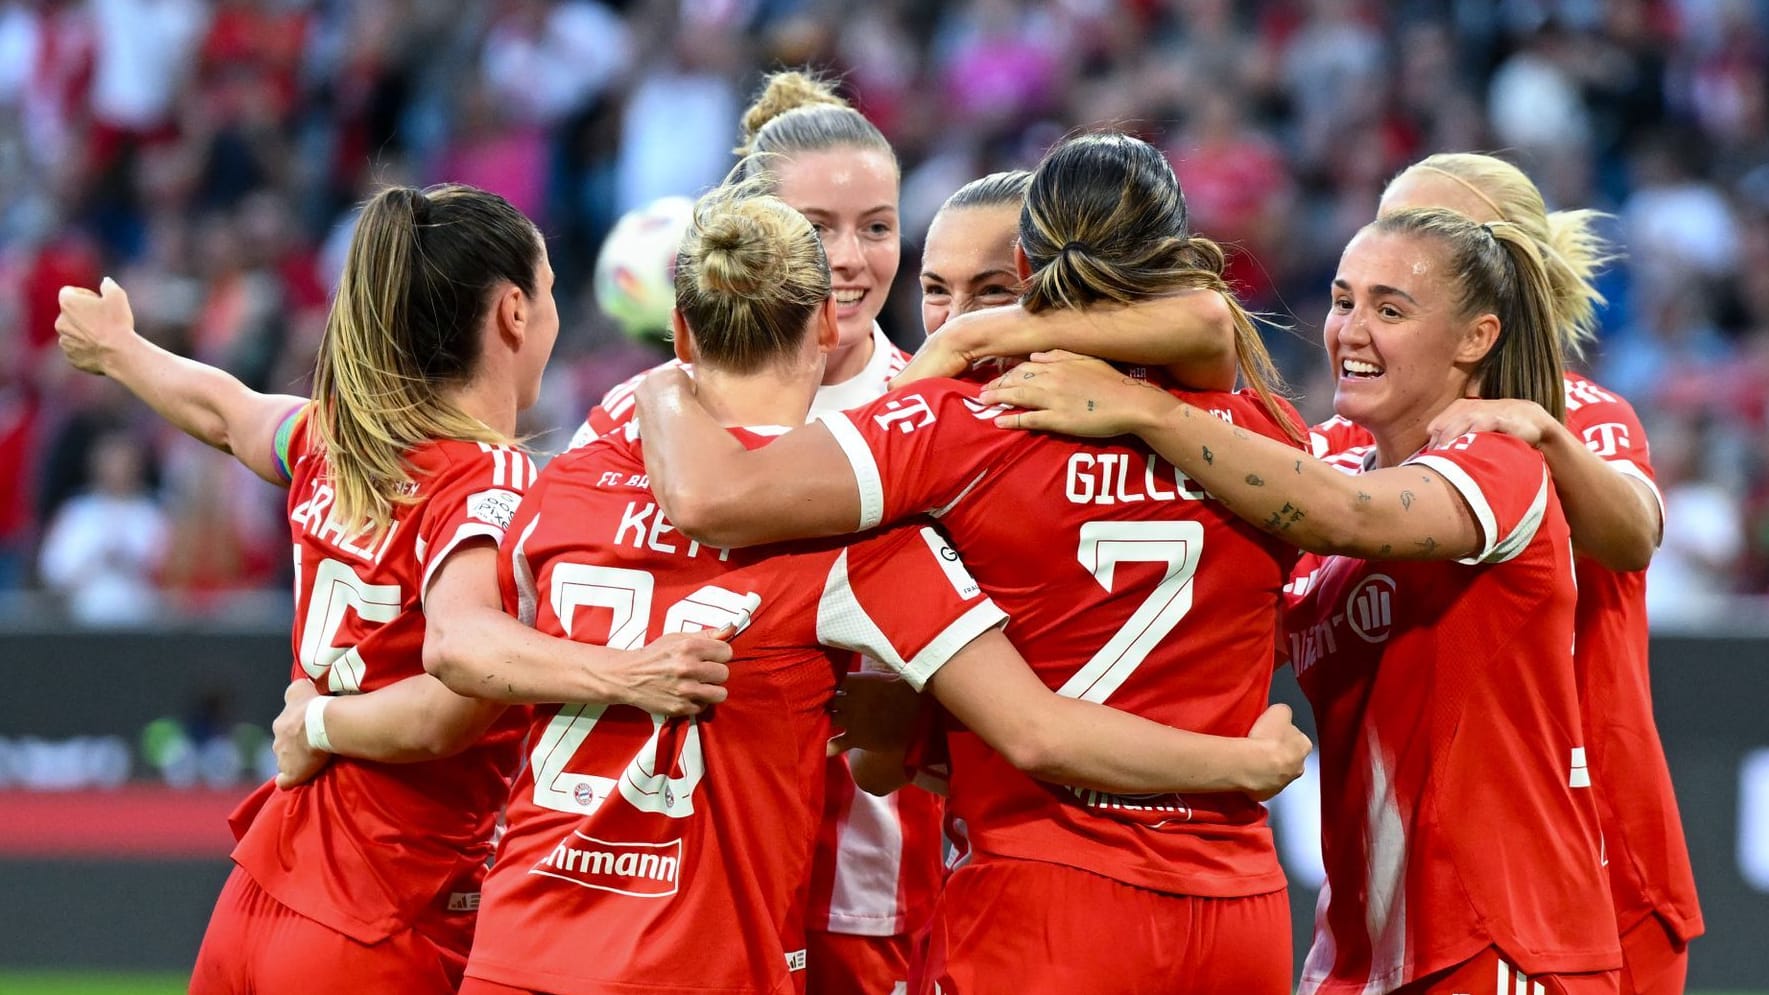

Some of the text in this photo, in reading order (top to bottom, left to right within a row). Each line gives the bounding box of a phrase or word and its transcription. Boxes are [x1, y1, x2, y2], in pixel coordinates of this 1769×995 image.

[596, 471, 622, 487] FC
[1065, 452, 1217, 505] GILLE
[613, 501, 730, 562] KE
